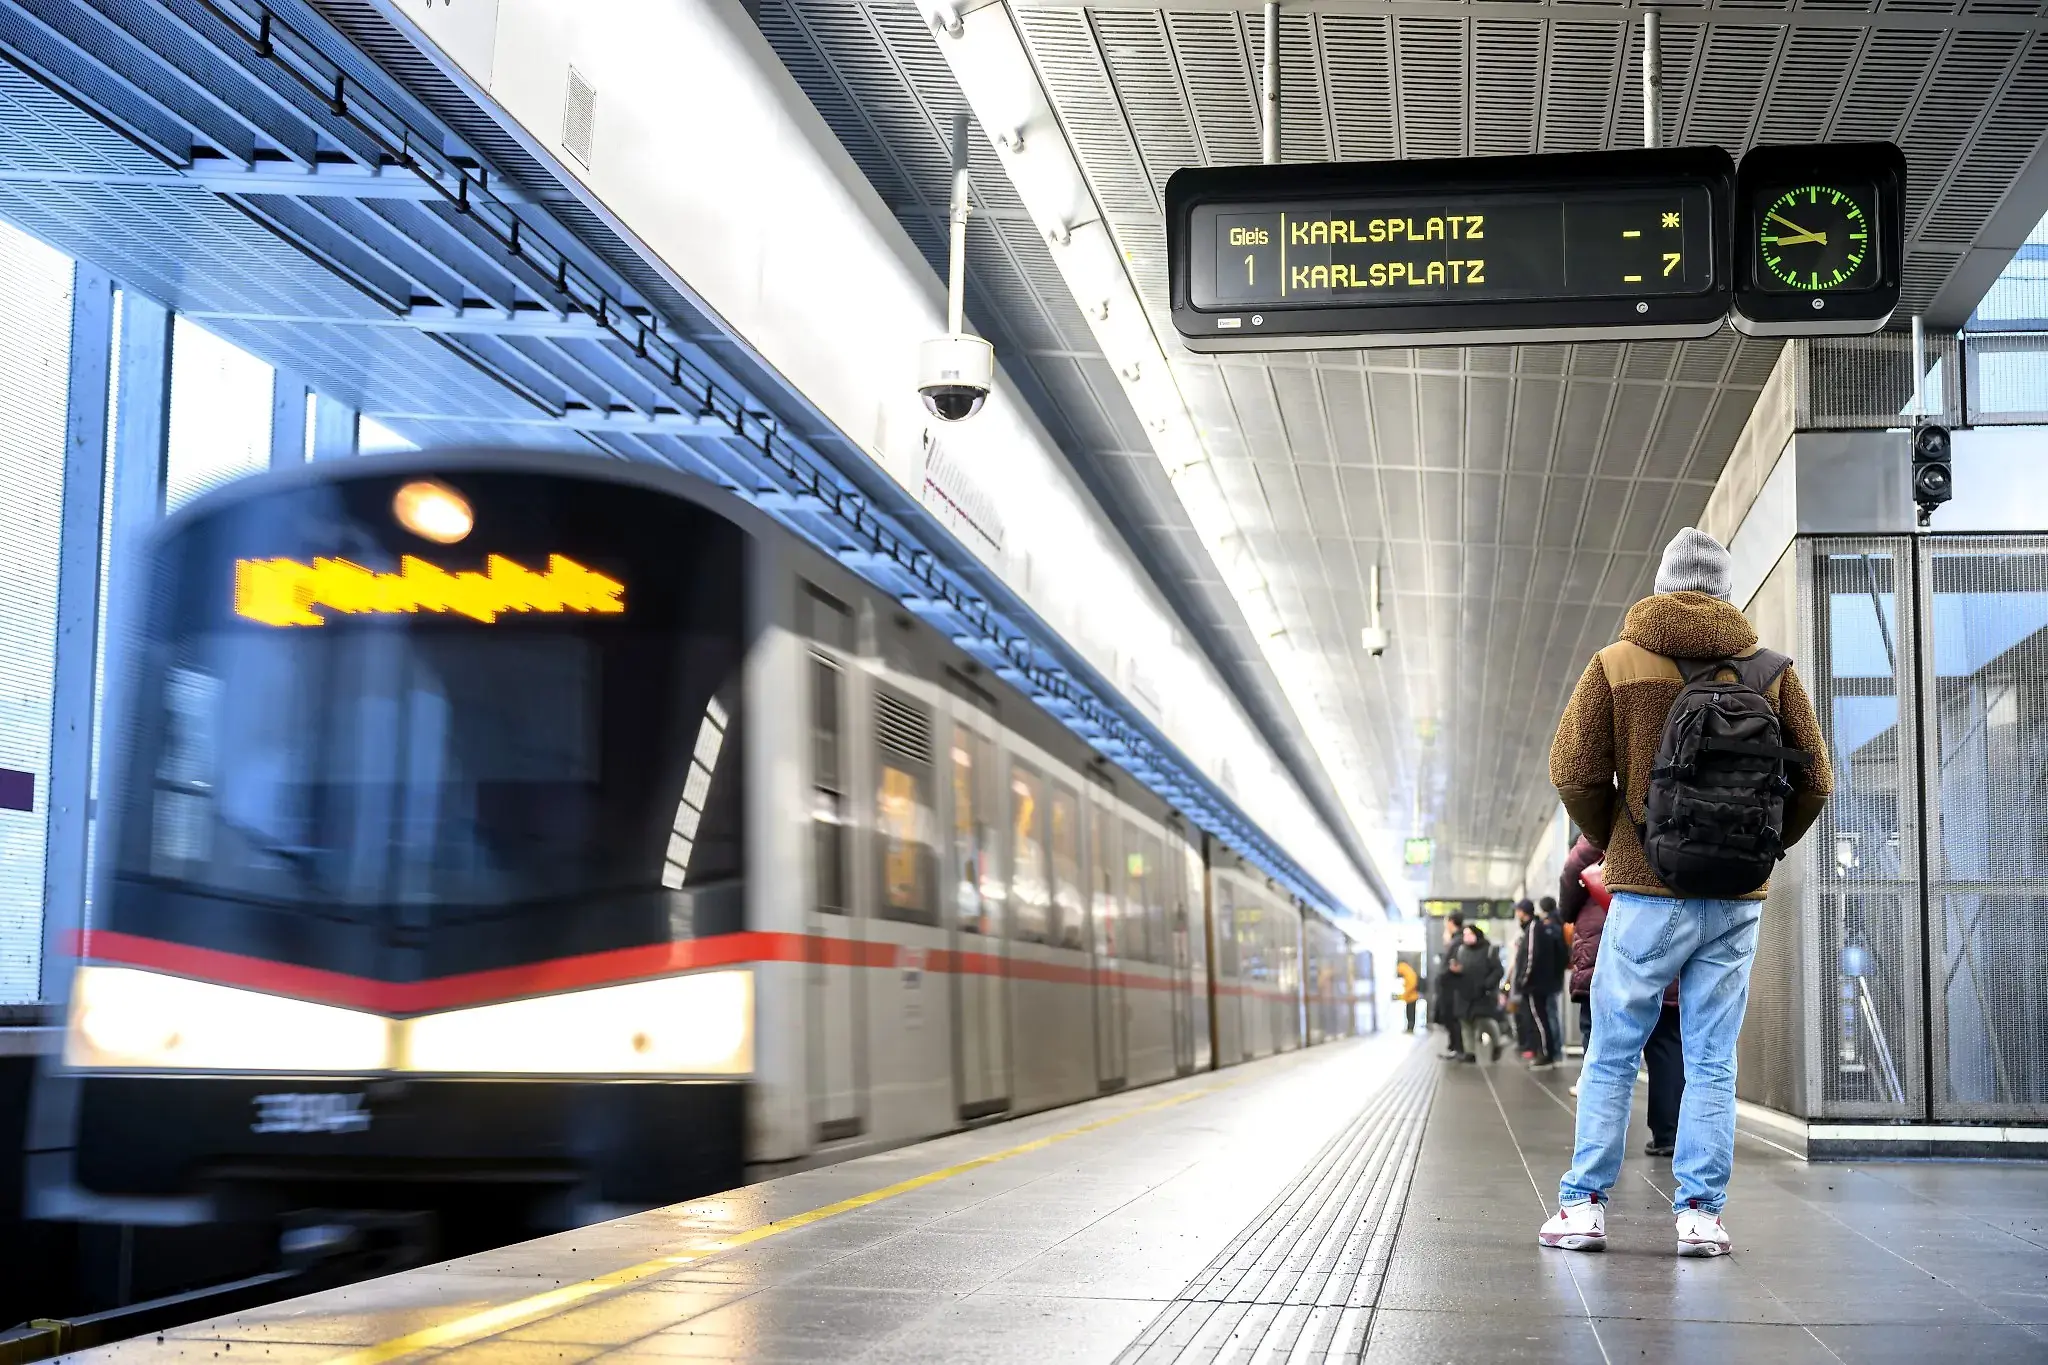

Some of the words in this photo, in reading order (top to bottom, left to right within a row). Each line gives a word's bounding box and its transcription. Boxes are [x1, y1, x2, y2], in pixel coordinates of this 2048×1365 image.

[1229, 227, 1269, 246] Gleis
[1291, 215, 1484, 245] KARLSPLATZ
[1244, 254, 1254, 286] 1
[1291, 259, 1485, 289] KARLSPLATZ
[1663, 252, 1681, 277] 7
